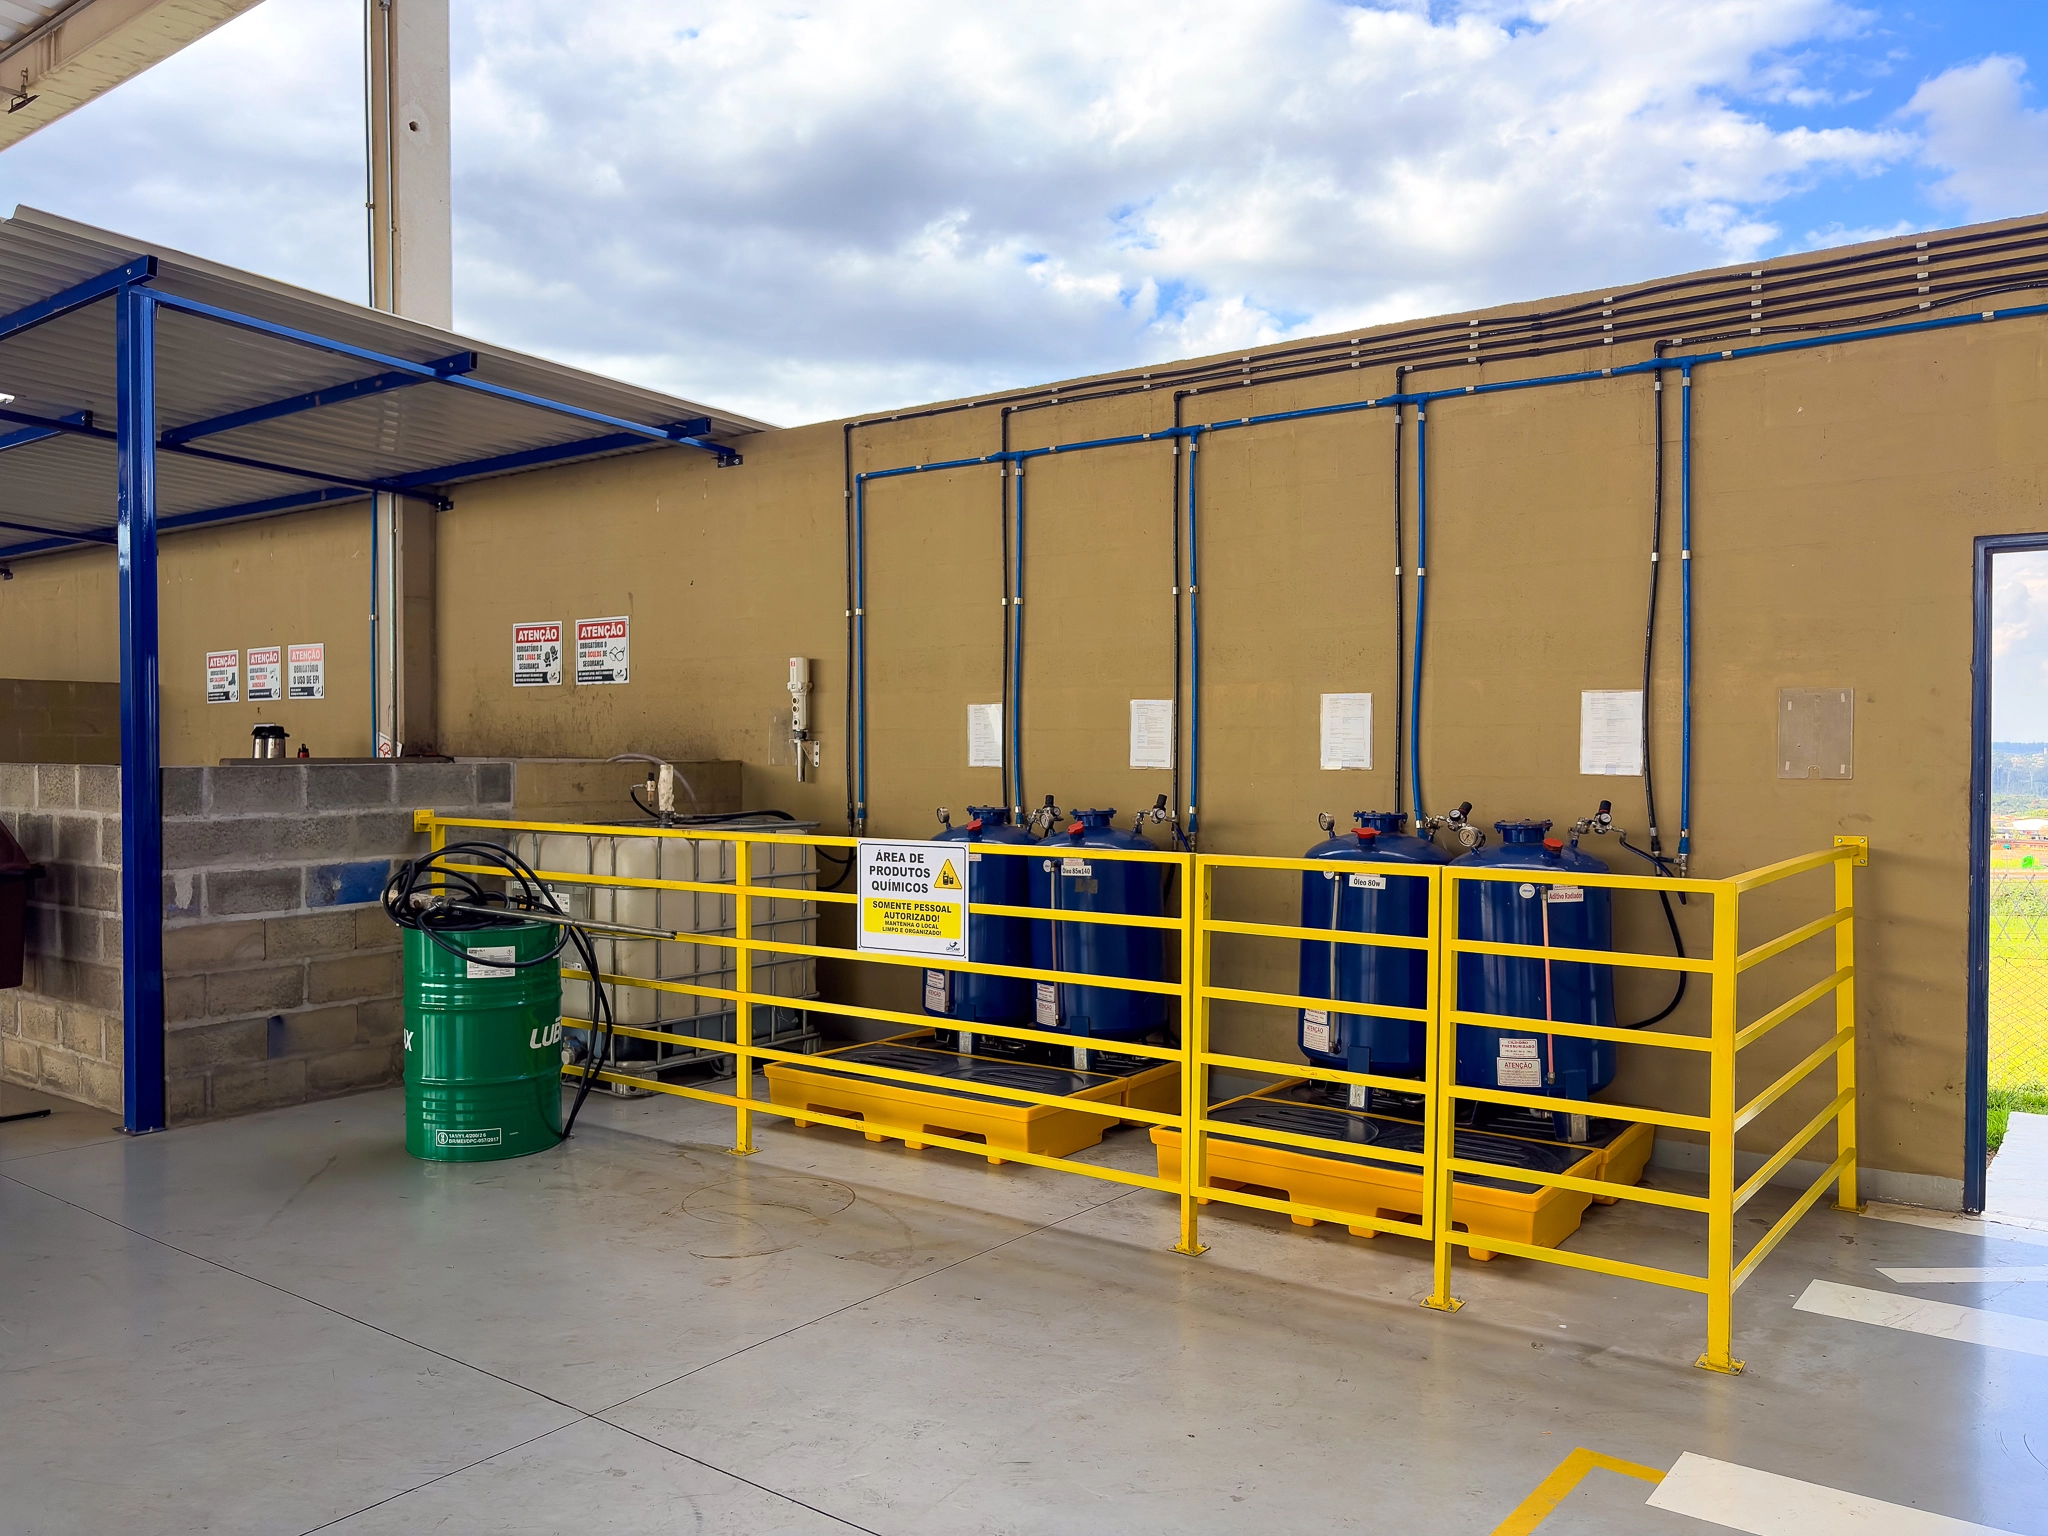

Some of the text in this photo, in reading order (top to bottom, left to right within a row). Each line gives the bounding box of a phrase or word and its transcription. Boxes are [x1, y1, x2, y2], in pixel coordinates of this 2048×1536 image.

[518, 627, 557, 642] ATENÇÃO
[581, 622, 623, 638] ATENÇÃO
[251, 652, 277, 664] ATENÇÃO
[292, 648, 320, 661] ATENÇÃO
[210, 655, 235, 667] ATENÇÃO
[297, 676, 305, 684] USO
[306, 675, 312, 684] DE
[312, 675, 320, 684] EPI
[875, 849, 924, 864] ÁREA DE
[869, 865, 931, 878] PRODUTOS
[871, 879, 929, 894] QUÍMICOS
[1353, 876, 1381, 887] Óleo 80w
[872, 900, 951, 913] SOMENTE PESSOAL
[884, 912, 940, 922] AUTORIZADO!
[884, 920, 915, 928] MANTENHA
[904, 928, 942, 936] ORGANIZADO!
[1504, 1061, 1533, 1070] ATENÇÃO
